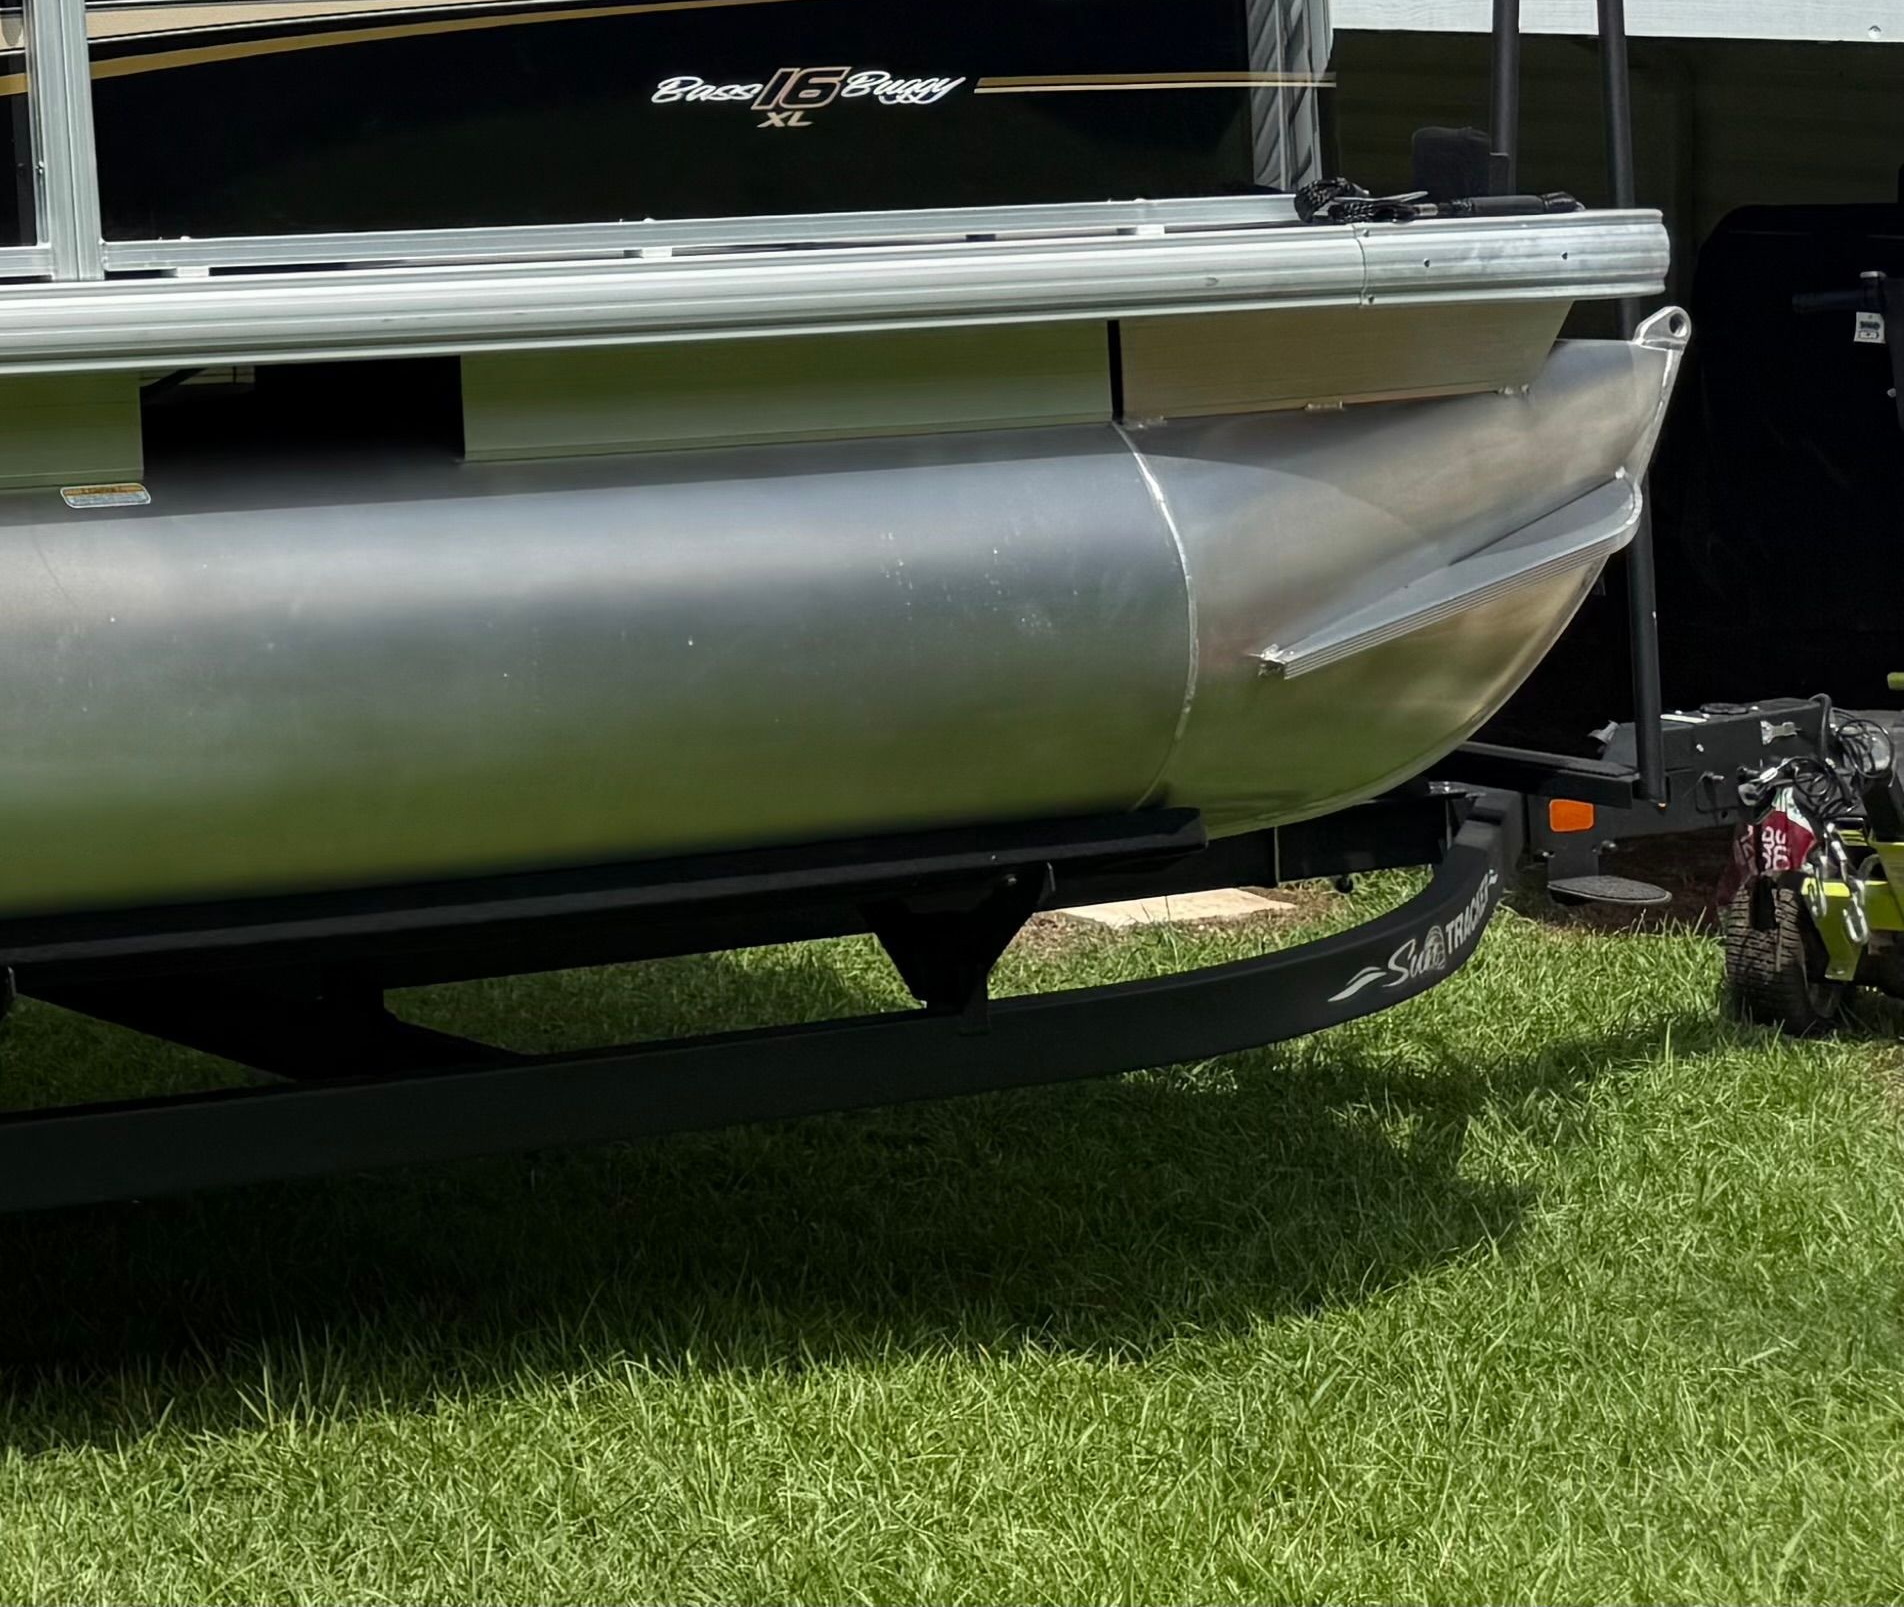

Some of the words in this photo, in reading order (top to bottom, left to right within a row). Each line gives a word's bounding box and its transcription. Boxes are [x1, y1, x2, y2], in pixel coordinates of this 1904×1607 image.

[650, 75, 764, 104] Bass
[750, 66, 852, 111] 16
[840, 70, 967, 105] Buggy
[756, 110, 813, 128] XL
